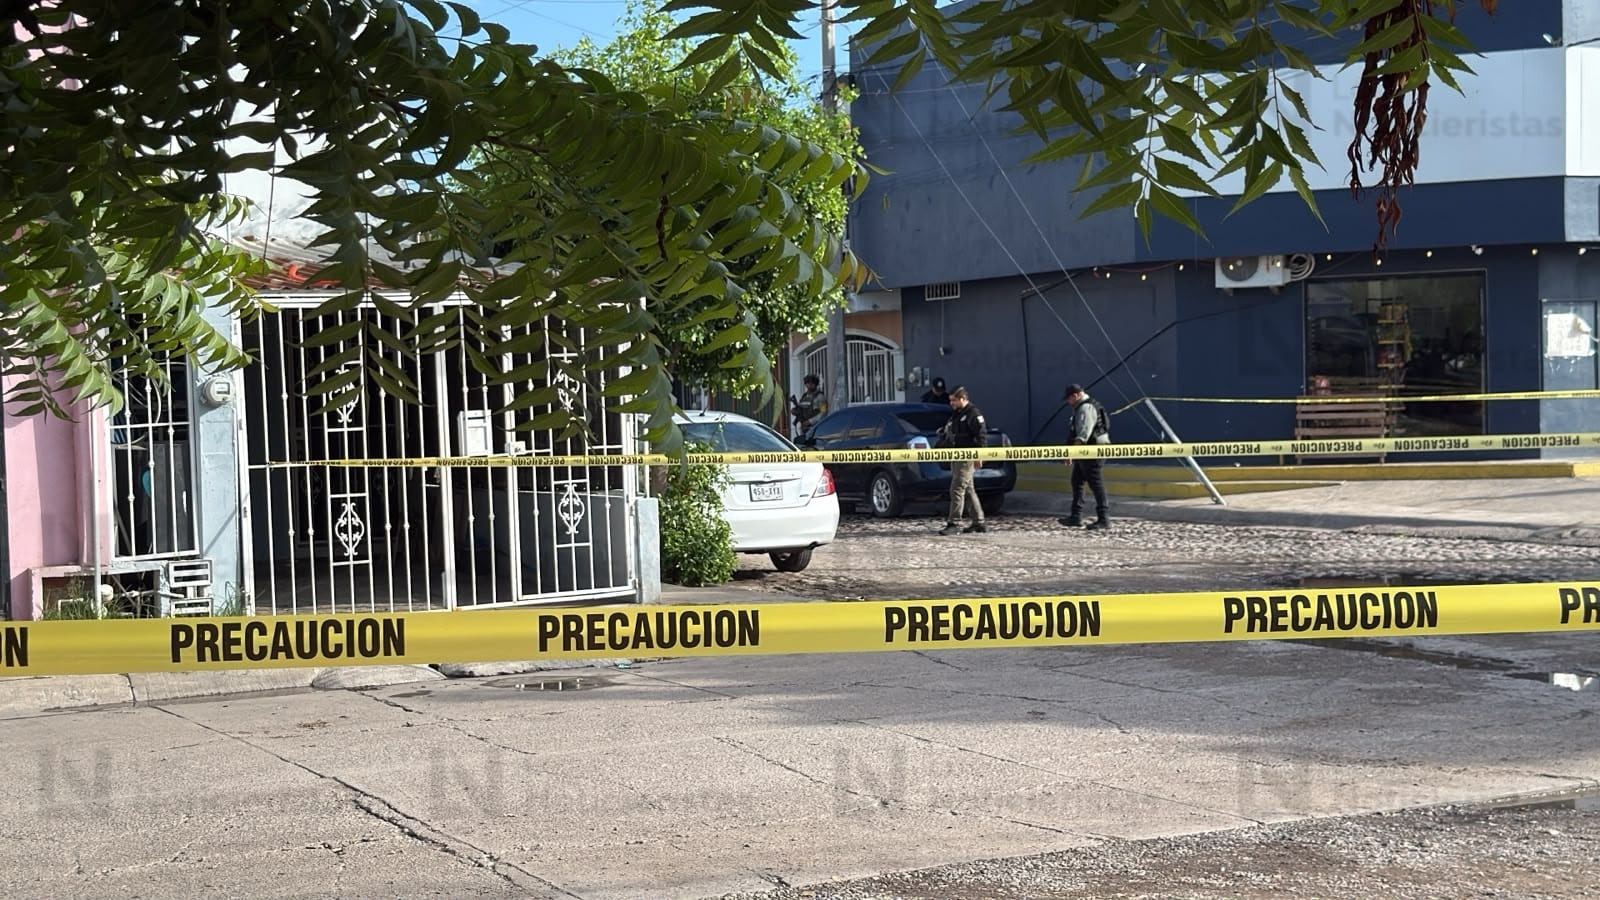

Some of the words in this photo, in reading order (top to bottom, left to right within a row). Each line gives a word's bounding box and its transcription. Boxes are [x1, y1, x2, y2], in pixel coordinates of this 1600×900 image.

[512, 457, 565, 466] PRECAUCION
[588, 456, 643, 465] PRECAUCION
[667, 455, 724, 465] PRECAUON
[748, 453, 806, 463] PRECAUCION
[831, 452, 891, 462] PRECAUCION
[917, 450, 979, 460] PRECAUCION
[1005, 448, 1069, 459] PRECAUCION
[1097, 446, 1163, 457] PRECAUCION
[1192, 443, 1261, 455] PRECAUCION
[1291, 441, 1362, 453] PRECAUCION
[1394, 438, 1469, 451] PRECAUCION
[1502, 436, 1580, 448] PRECAUCION
[0, 627, 28, 667] N
[171, 618, 404, 663] PRECAUCION
[539, 610, 759, 652] PRECAUCION
[885, 601, 1100, 643] PRECAUCION
[1224, 592, 1437, 633] PRECAUCION
